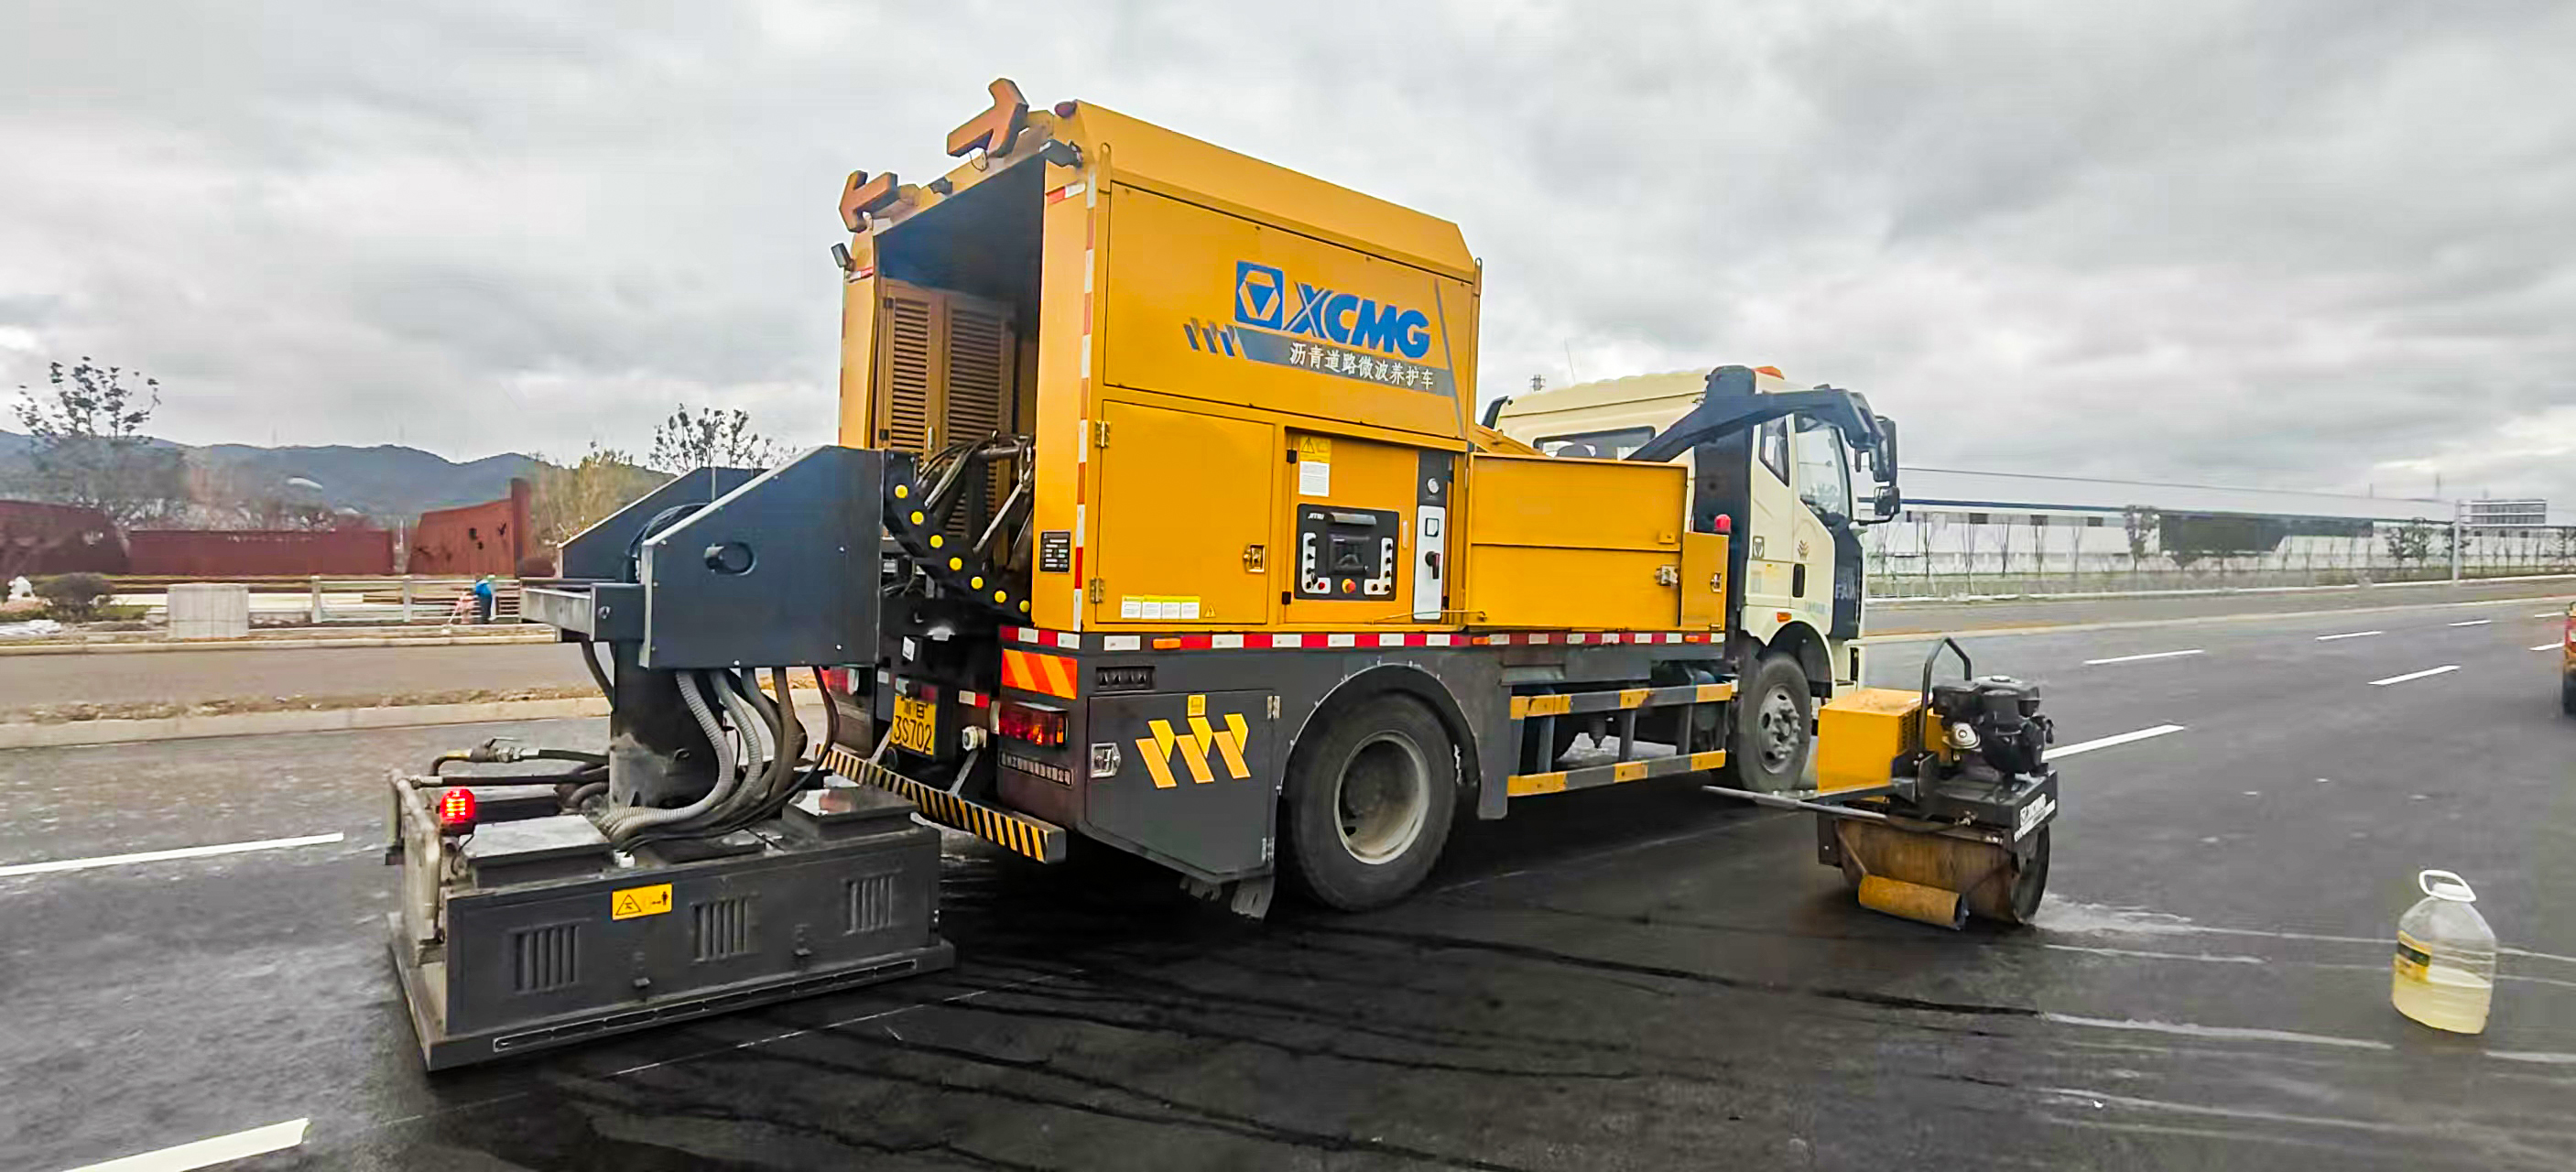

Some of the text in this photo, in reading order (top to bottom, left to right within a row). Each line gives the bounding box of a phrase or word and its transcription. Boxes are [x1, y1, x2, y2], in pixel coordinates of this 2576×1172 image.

[1282, 282, 1430, 358] XCMG
[1289, 342, 1434, 391] 沥青道路微波养护车
[894, 715, 932, 754] 3S702
